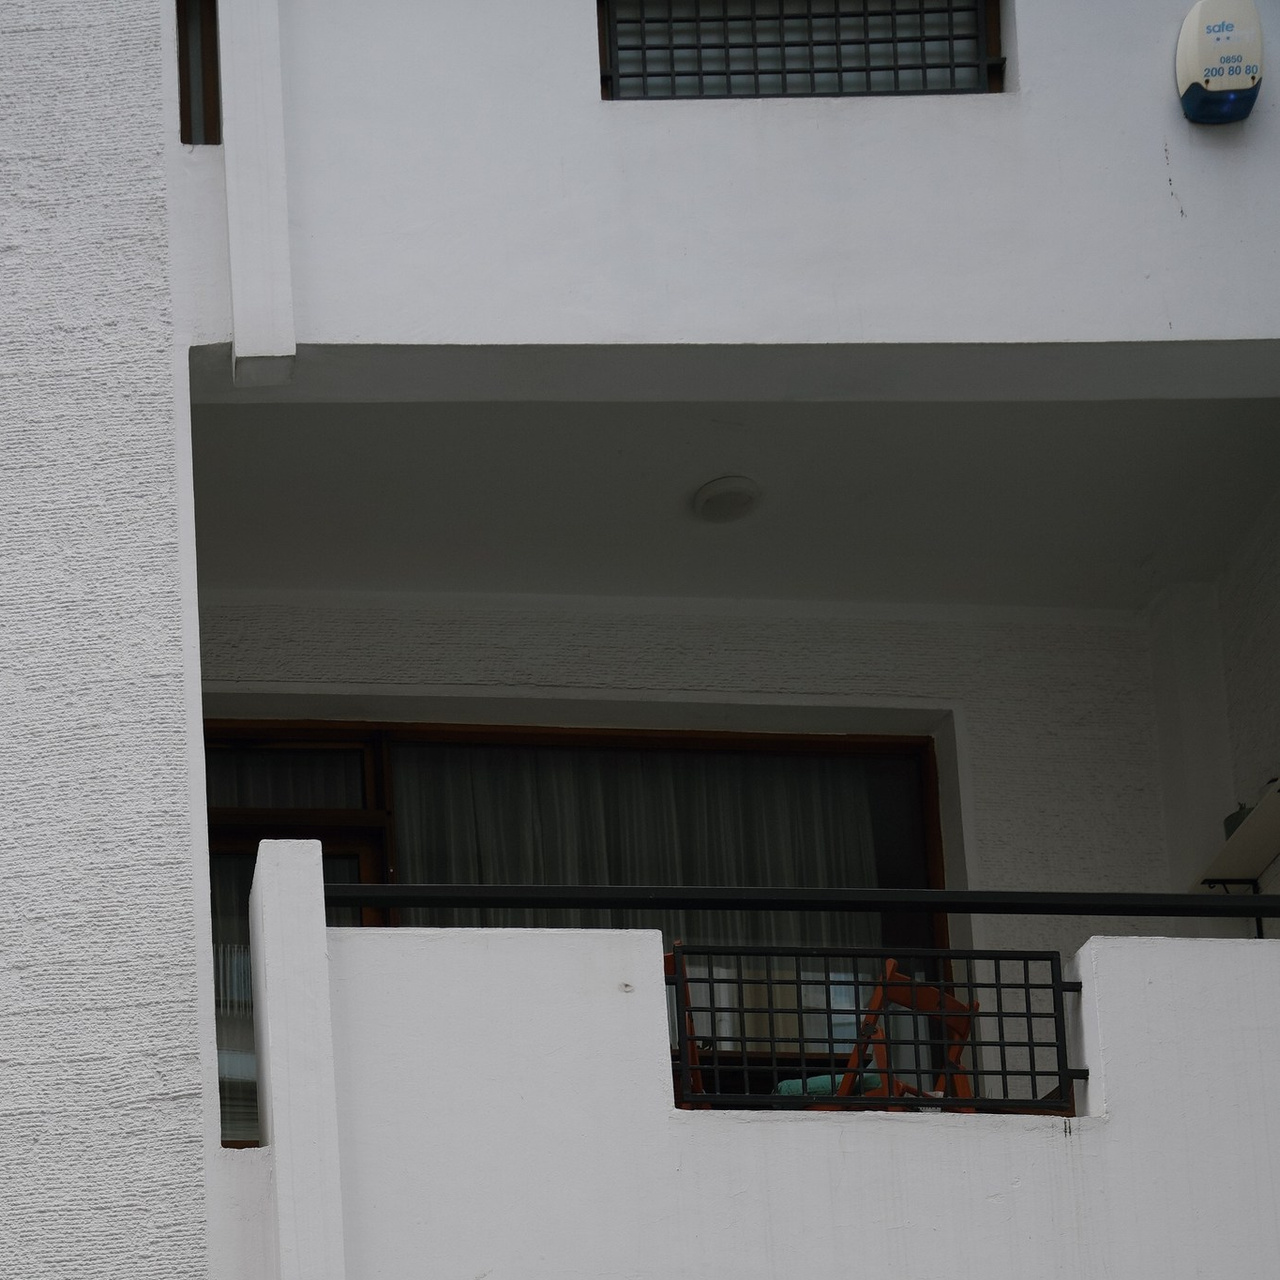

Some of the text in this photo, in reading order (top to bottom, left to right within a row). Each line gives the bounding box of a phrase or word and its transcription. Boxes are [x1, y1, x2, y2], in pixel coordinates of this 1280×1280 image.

[1206, 21, 1235, 34] safe
[1220, 55, 1243, 64] 0850
[1203, 65, 1258, 77] 200 80 80
